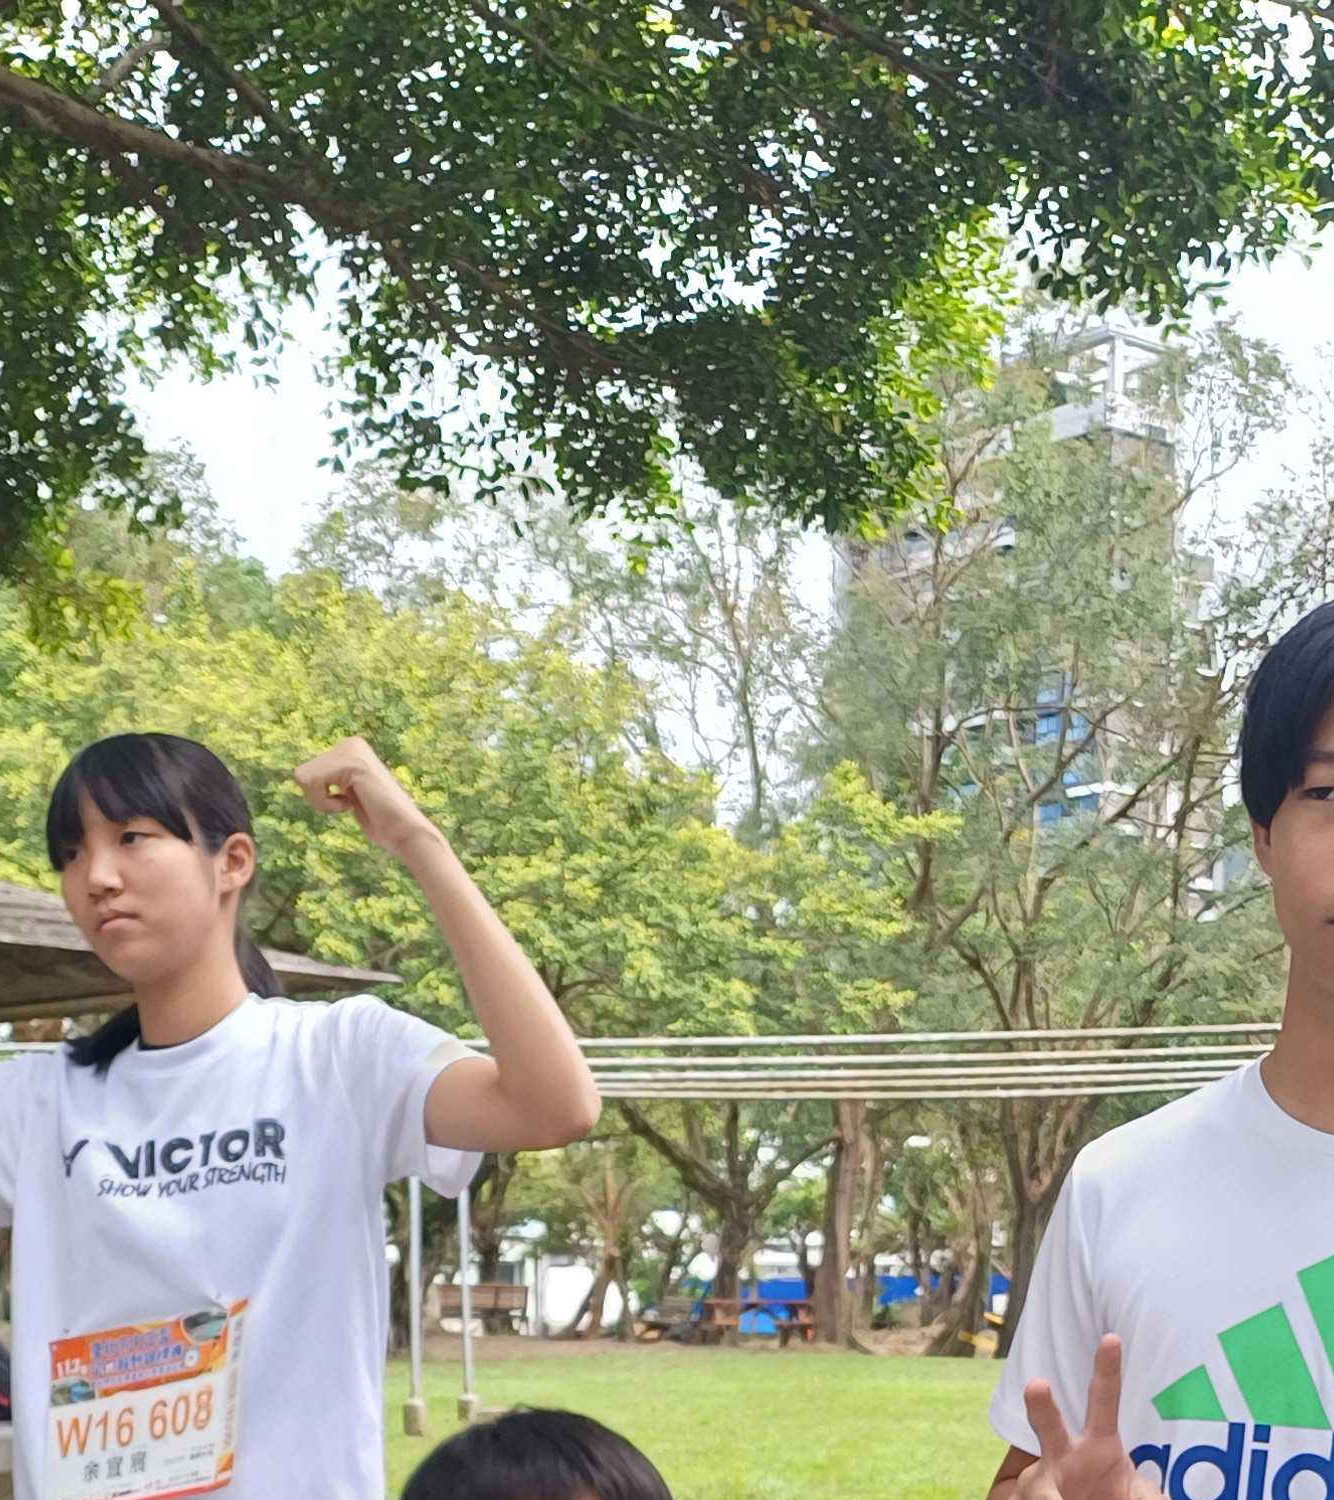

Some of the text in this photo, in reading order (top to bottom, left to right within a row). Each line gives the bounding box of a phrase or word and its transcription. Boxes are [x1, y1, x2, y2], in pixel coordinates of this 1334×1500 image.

[104, 1117, 287, 1179] VICTOR
[96, 1160, 287, 1199] SHOW YOUR STRENGTH
[57, 1406, 135, 1459] W16
[148, 1384, 216, 1442] 608
